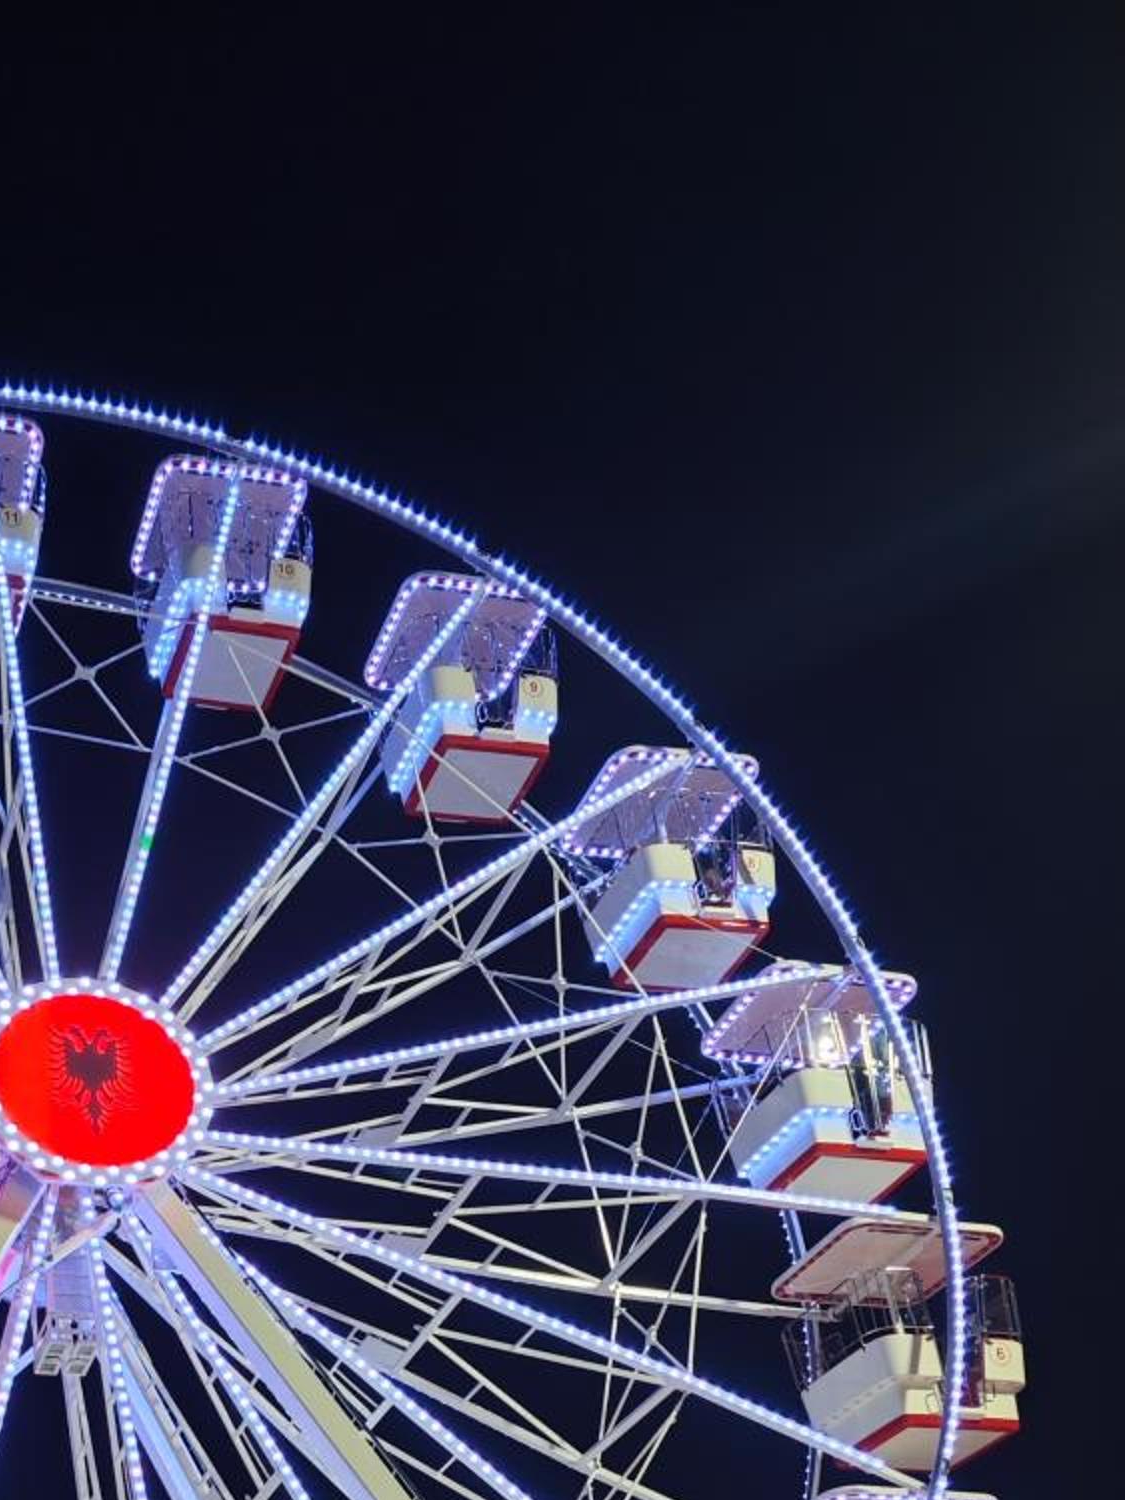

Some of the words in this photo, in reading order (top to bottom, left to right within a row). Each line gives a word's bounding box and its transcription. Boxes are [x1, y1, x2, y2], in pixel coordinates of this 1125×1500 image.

[4, 511, 19, 525] 11
[529, 681, 539, 694] 9
[996, 1346, 1006, 1361] 6
